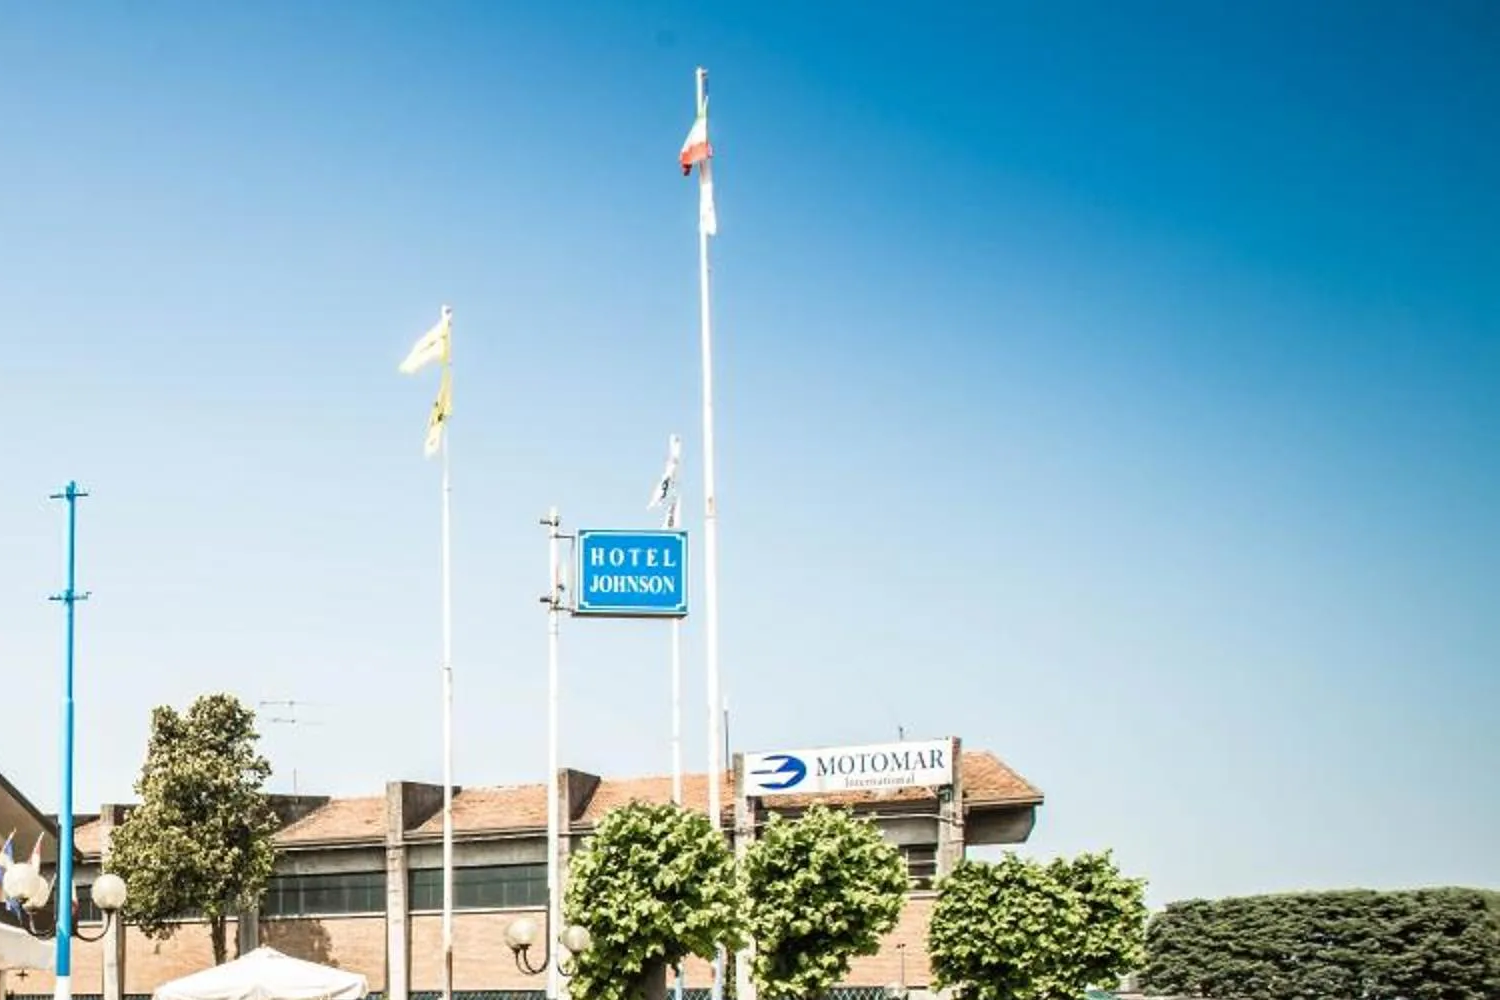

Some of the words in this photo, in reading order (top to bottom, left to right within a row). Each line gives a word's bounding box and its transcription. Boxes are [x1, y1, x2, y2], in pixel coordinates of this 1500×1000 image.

[590, 547, 676, 567] HOTEL
[589, 574, 675, 594] JOHNSON
[816, 749, 945, 777] MOTOMAR
[844, 773, 915, 788] International
